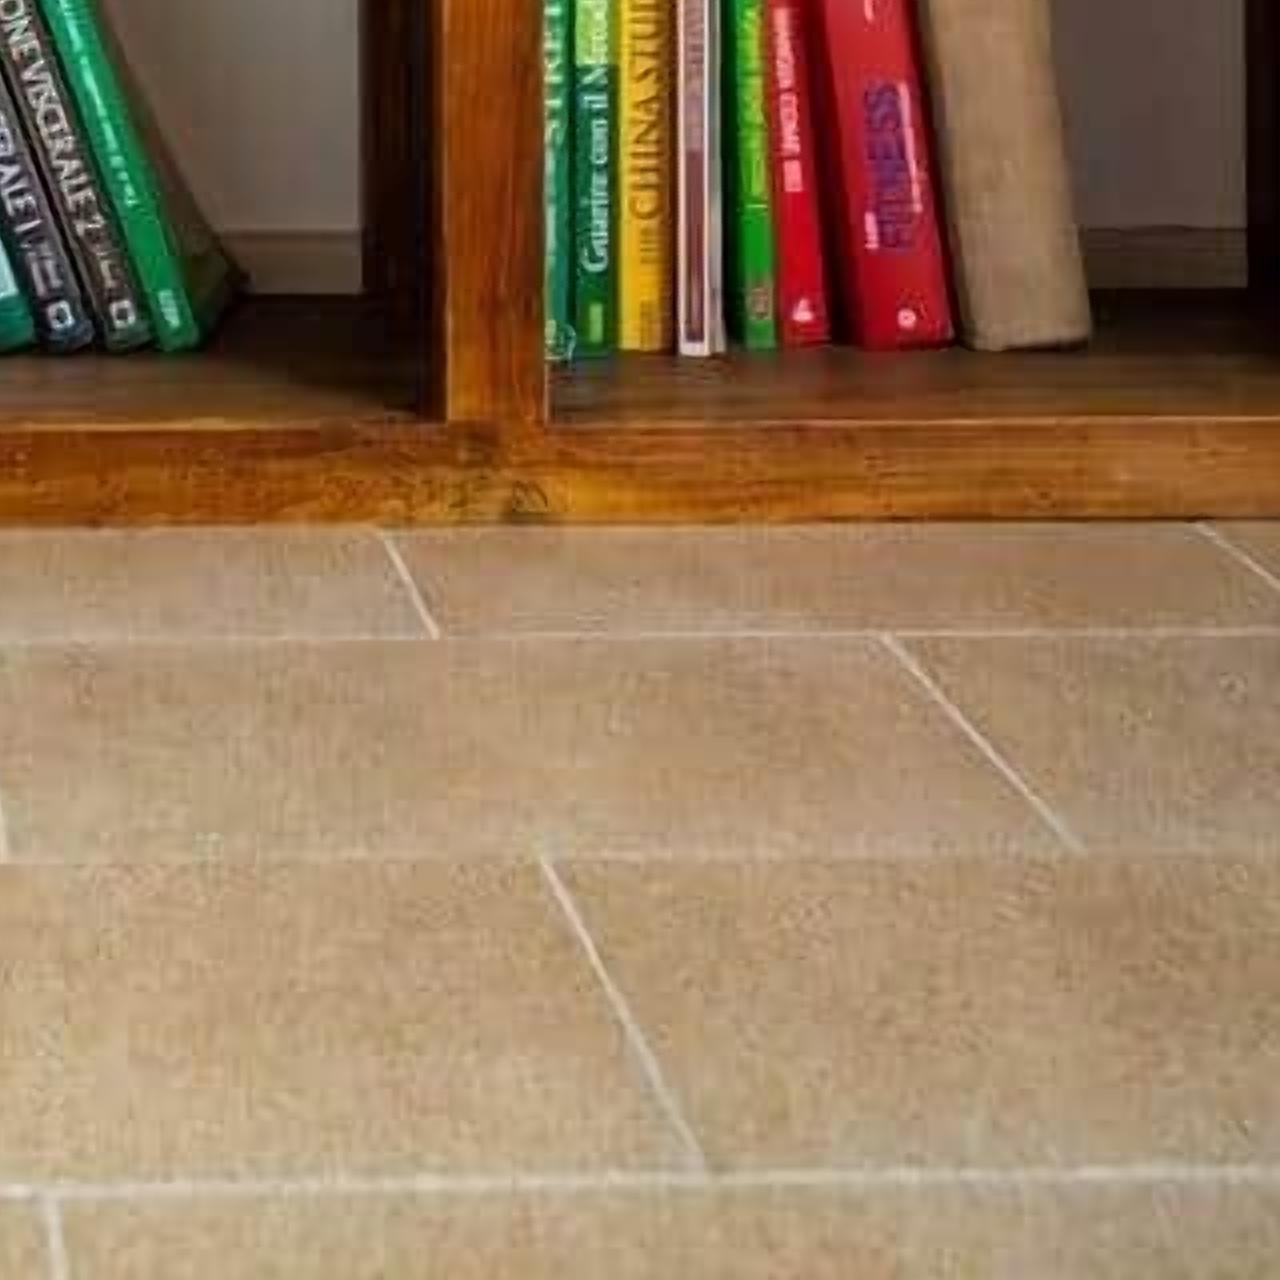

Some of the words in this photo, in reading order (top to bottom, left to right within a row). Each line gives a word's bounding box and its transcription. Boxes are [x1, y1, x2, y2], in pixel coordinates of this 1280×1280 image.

[22, 60, 98, 217] VISCERALE
[582, 93, 608, 110] il
[588, 117, 608, 164] con
[628, 99, 665, 221] CHINA
[867, 82, 912, 250] FITNESS
[580, 171, 610, 274] Guarire
